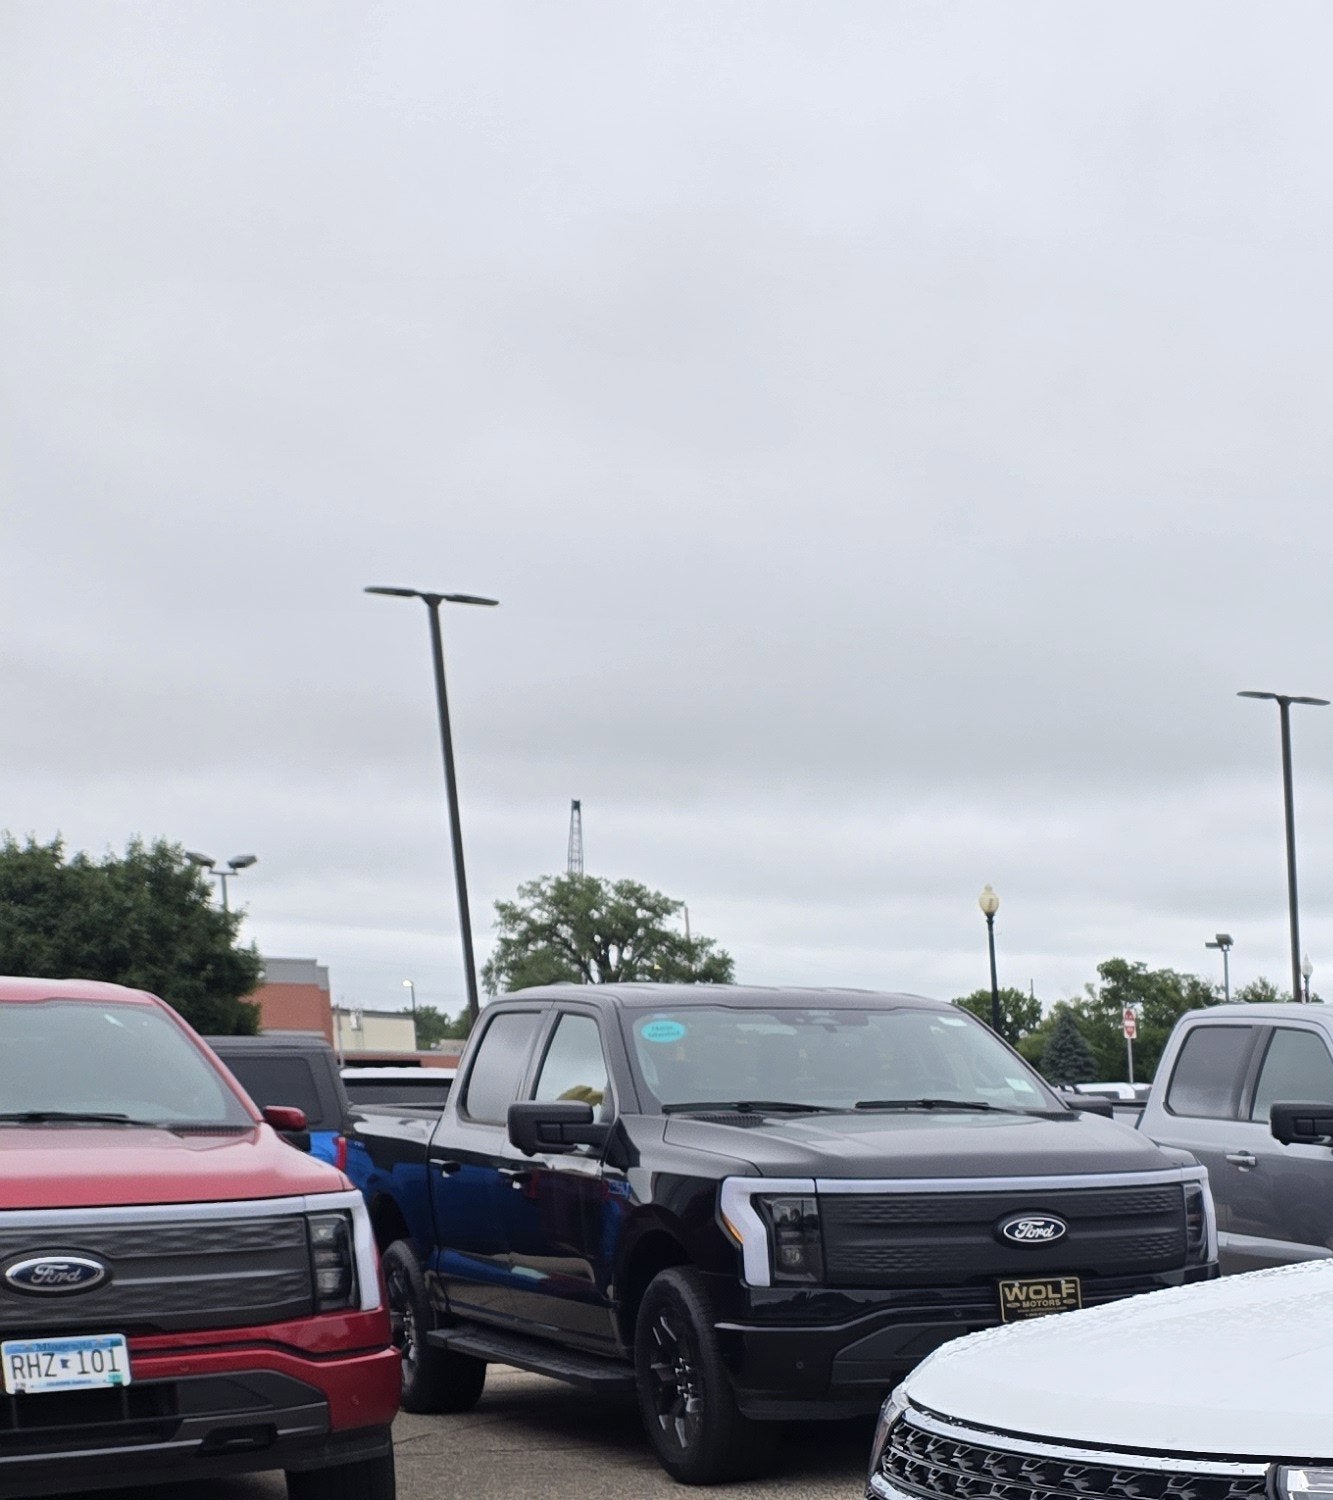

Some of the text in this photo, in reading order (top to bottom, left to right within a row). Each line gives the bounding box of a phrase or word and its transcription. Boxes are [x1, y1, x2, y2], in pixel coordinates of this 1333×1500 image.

[1014, 1220, 1055, 1238] Ford
[30, 1264, 81, 1284] Ford
[1004, 1283, 1076, 1301] WOLF
[1022, 1299, 1061, 1308] MOTORS
[10, 1348, 121, 1379] RHZ 101
